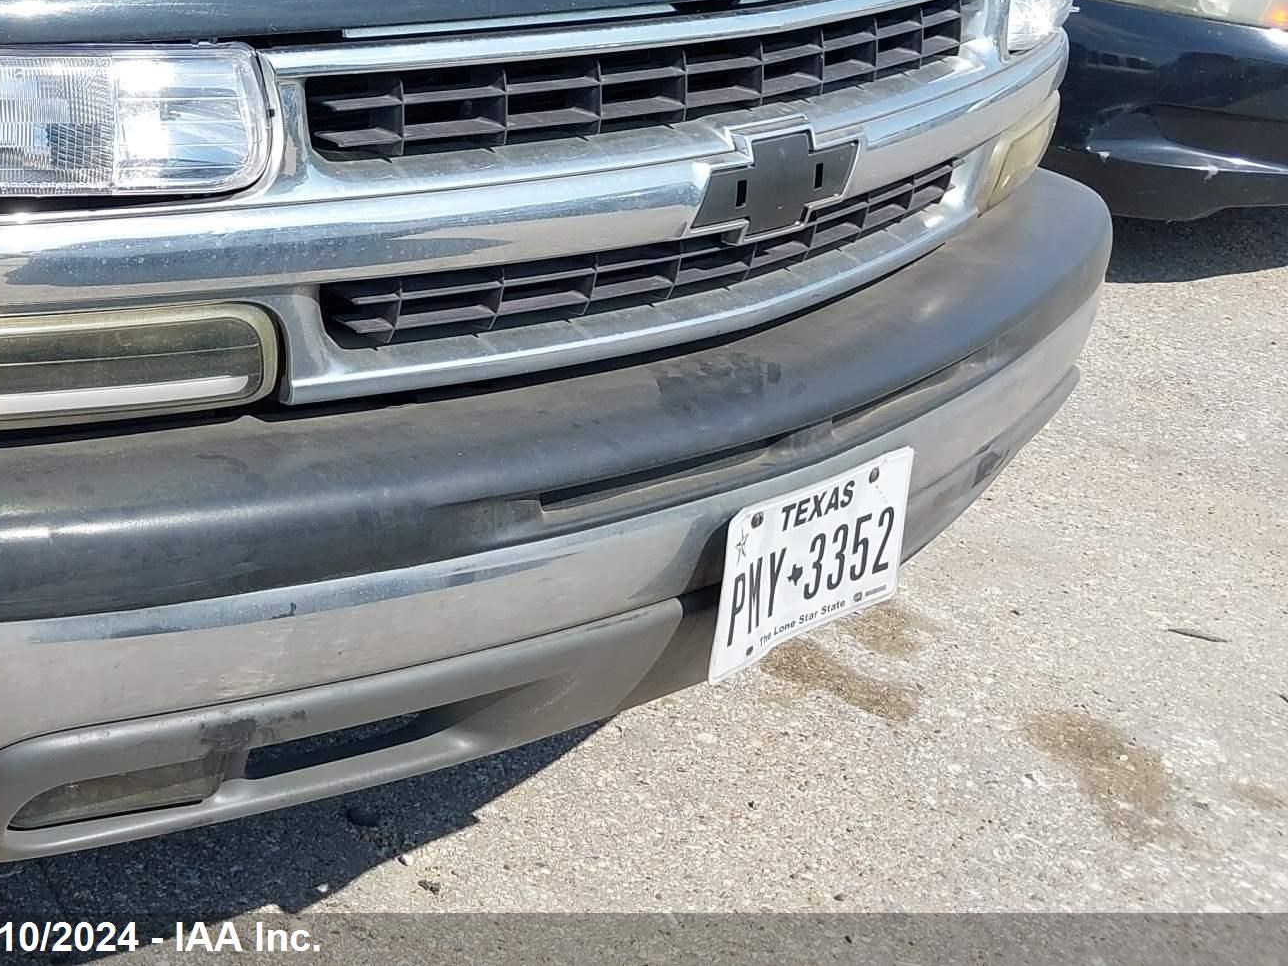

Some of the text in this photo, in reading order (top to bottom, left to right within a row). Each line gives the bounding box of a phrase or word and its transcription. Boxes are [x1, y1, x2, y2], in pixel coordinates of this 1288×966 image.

[781, 480, 855, 532] TEXAS
[726, 506, 895, 648] PMY 3352
[759, 599, 846, 647] The Lone Star State
